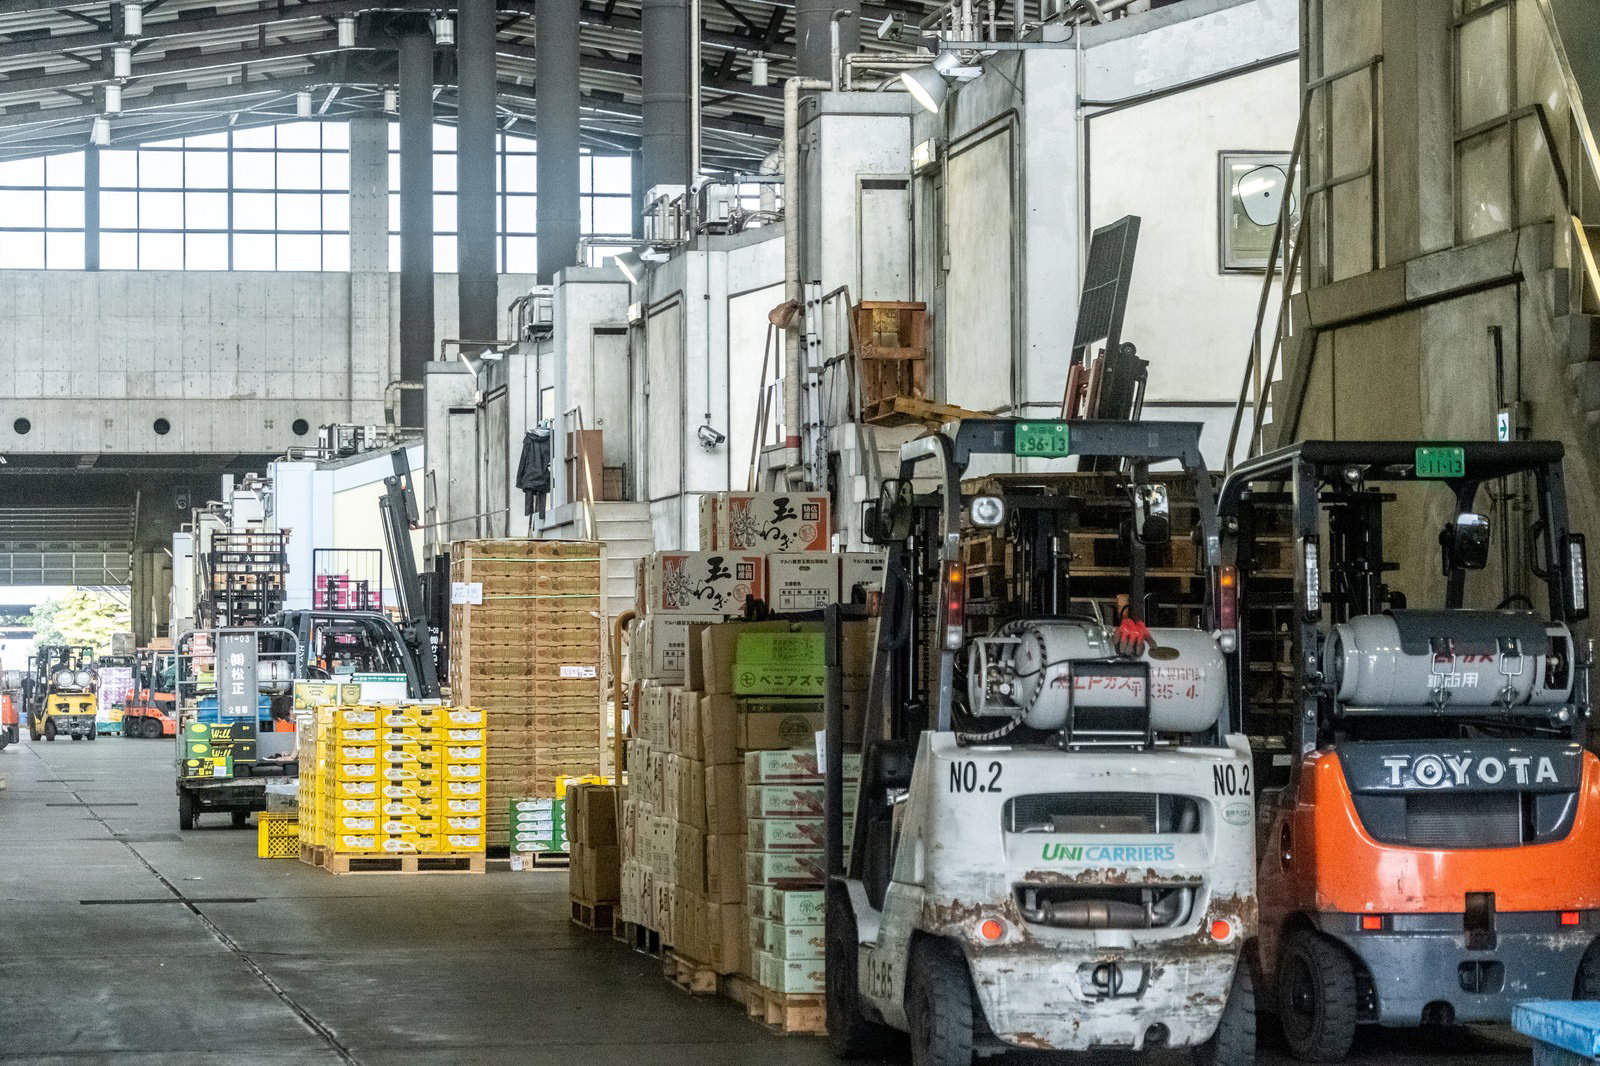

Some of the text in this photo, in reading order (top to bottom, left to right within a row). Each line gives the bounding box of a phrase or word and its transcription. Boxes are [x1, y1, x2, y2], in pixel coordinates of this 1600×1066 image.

[759, 497, 798, 552] 玉ねぎ
[693, 556, 732, 611] 玉ねぎ
[230, 652, 245, 695] ㈱松正
[759, 674, 824, 686] ベニアズマ
[211, 728, 231, 739] Will
[950, 760, 1002, 793] NO.2
[1213, 764, 1251, 796] NO.2
[1384, 756, 1559, 786] TOYOTA
[867, 957, 893, 1001] 11-85
